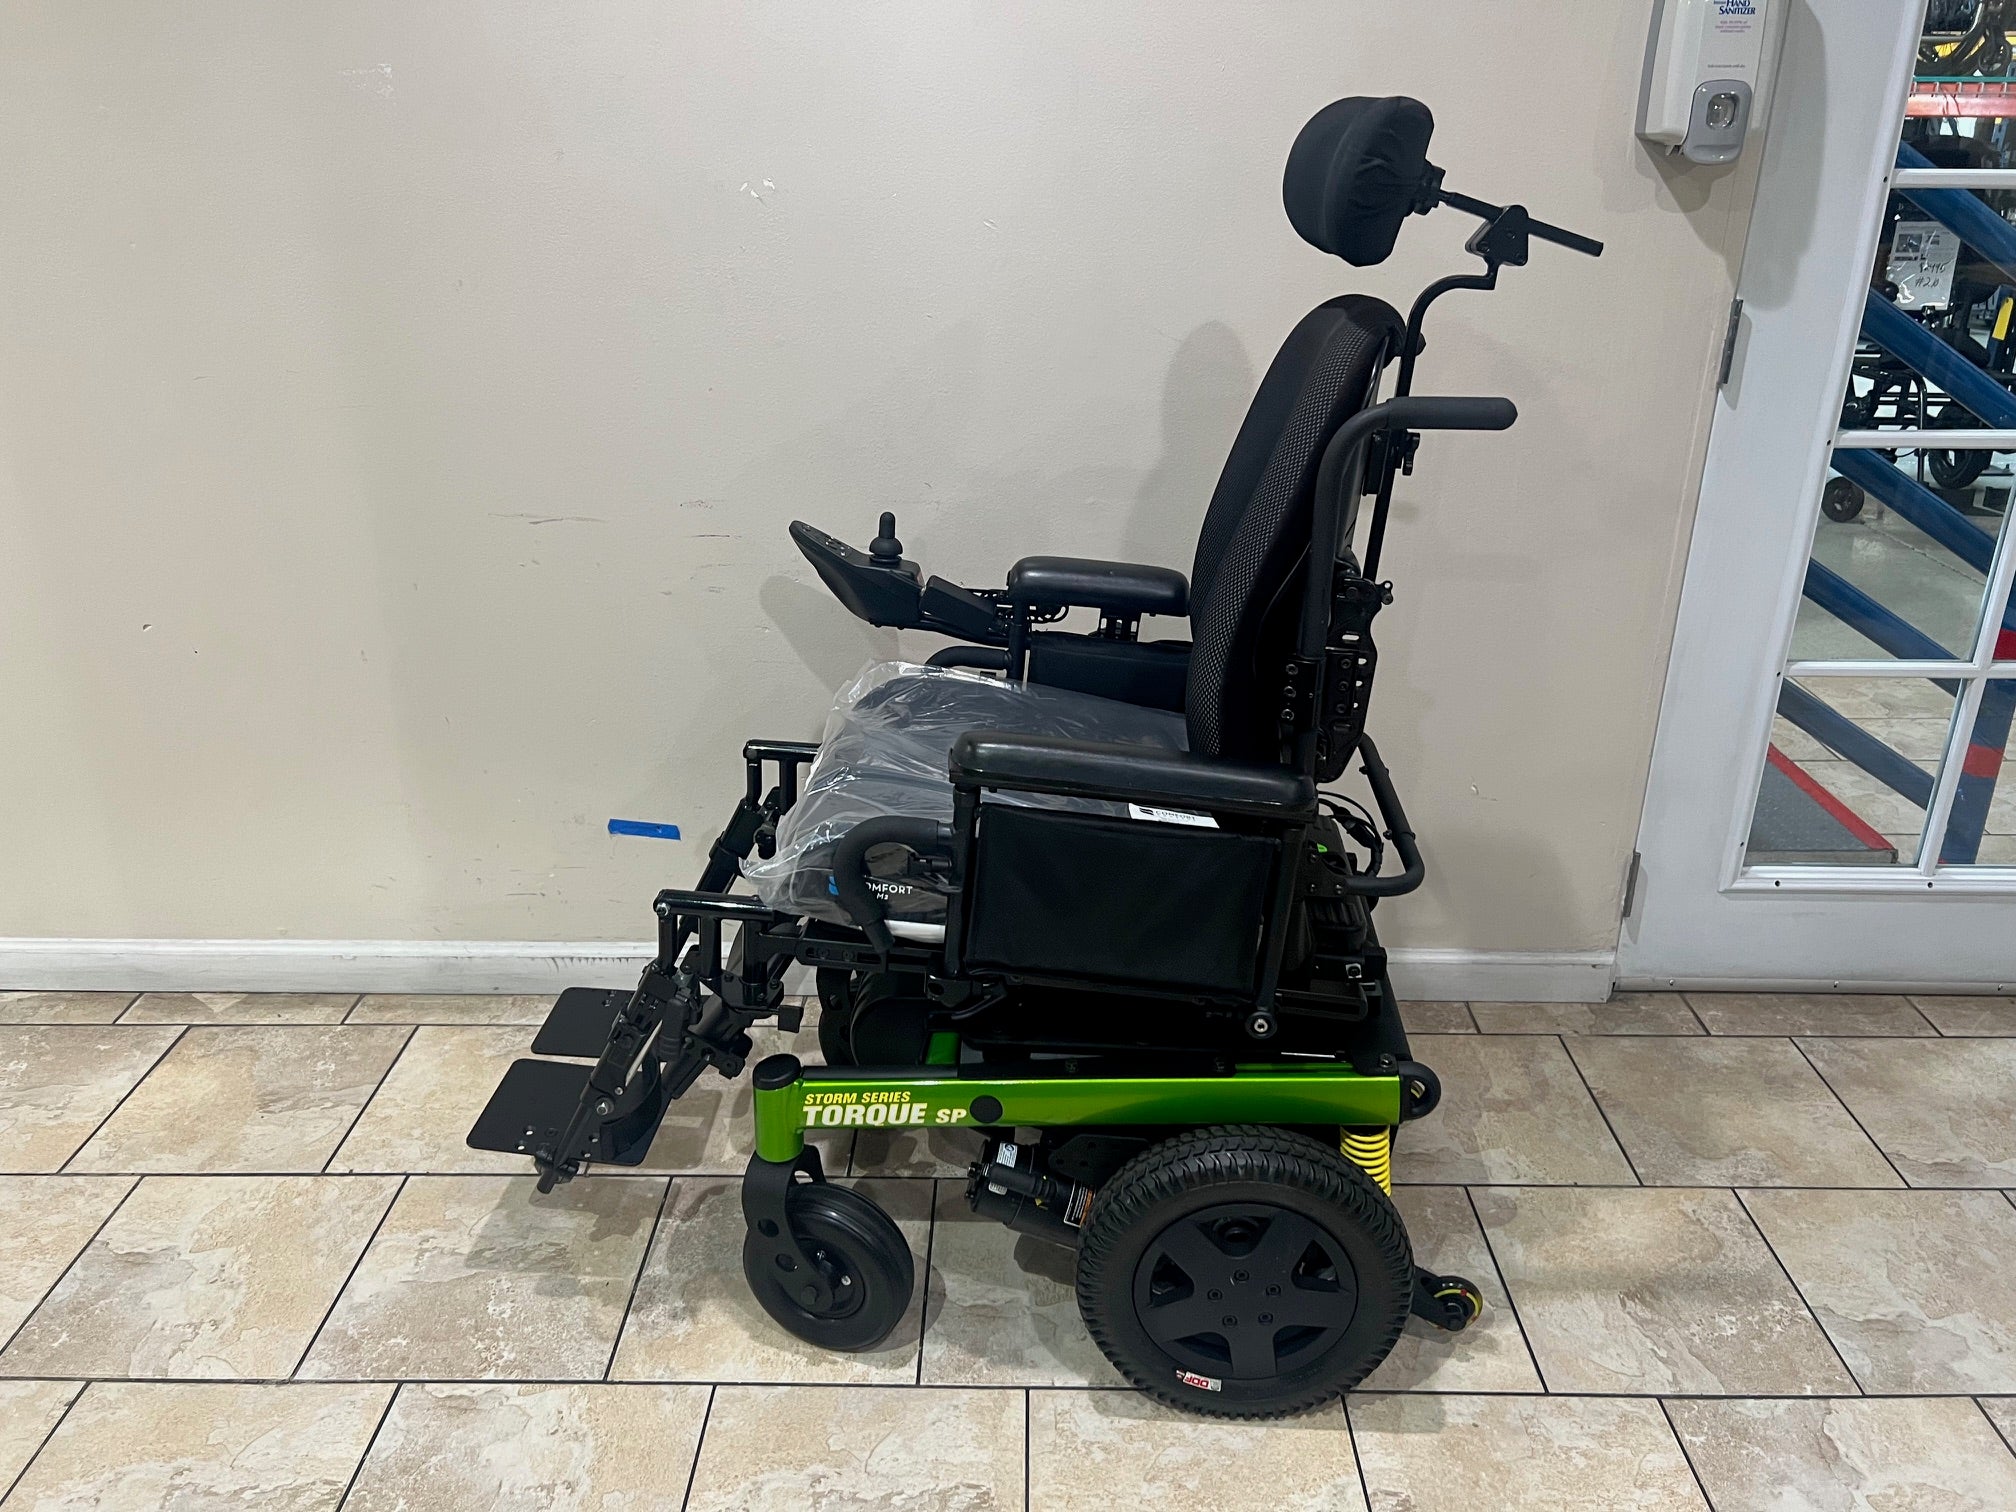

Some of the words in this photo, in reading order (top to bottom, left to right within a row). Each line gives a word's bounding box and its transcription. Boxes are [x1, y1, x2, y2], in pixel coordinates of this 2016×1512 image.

[1719, 6, 1756, 15] SANITIZER
[804, 1092, 858, 1105] STORM
[861, 1091, 912, 1103] SERIES
[802, 1103, 928, 1127] TORQUE
[935, 1108, 967, 1124] SP
